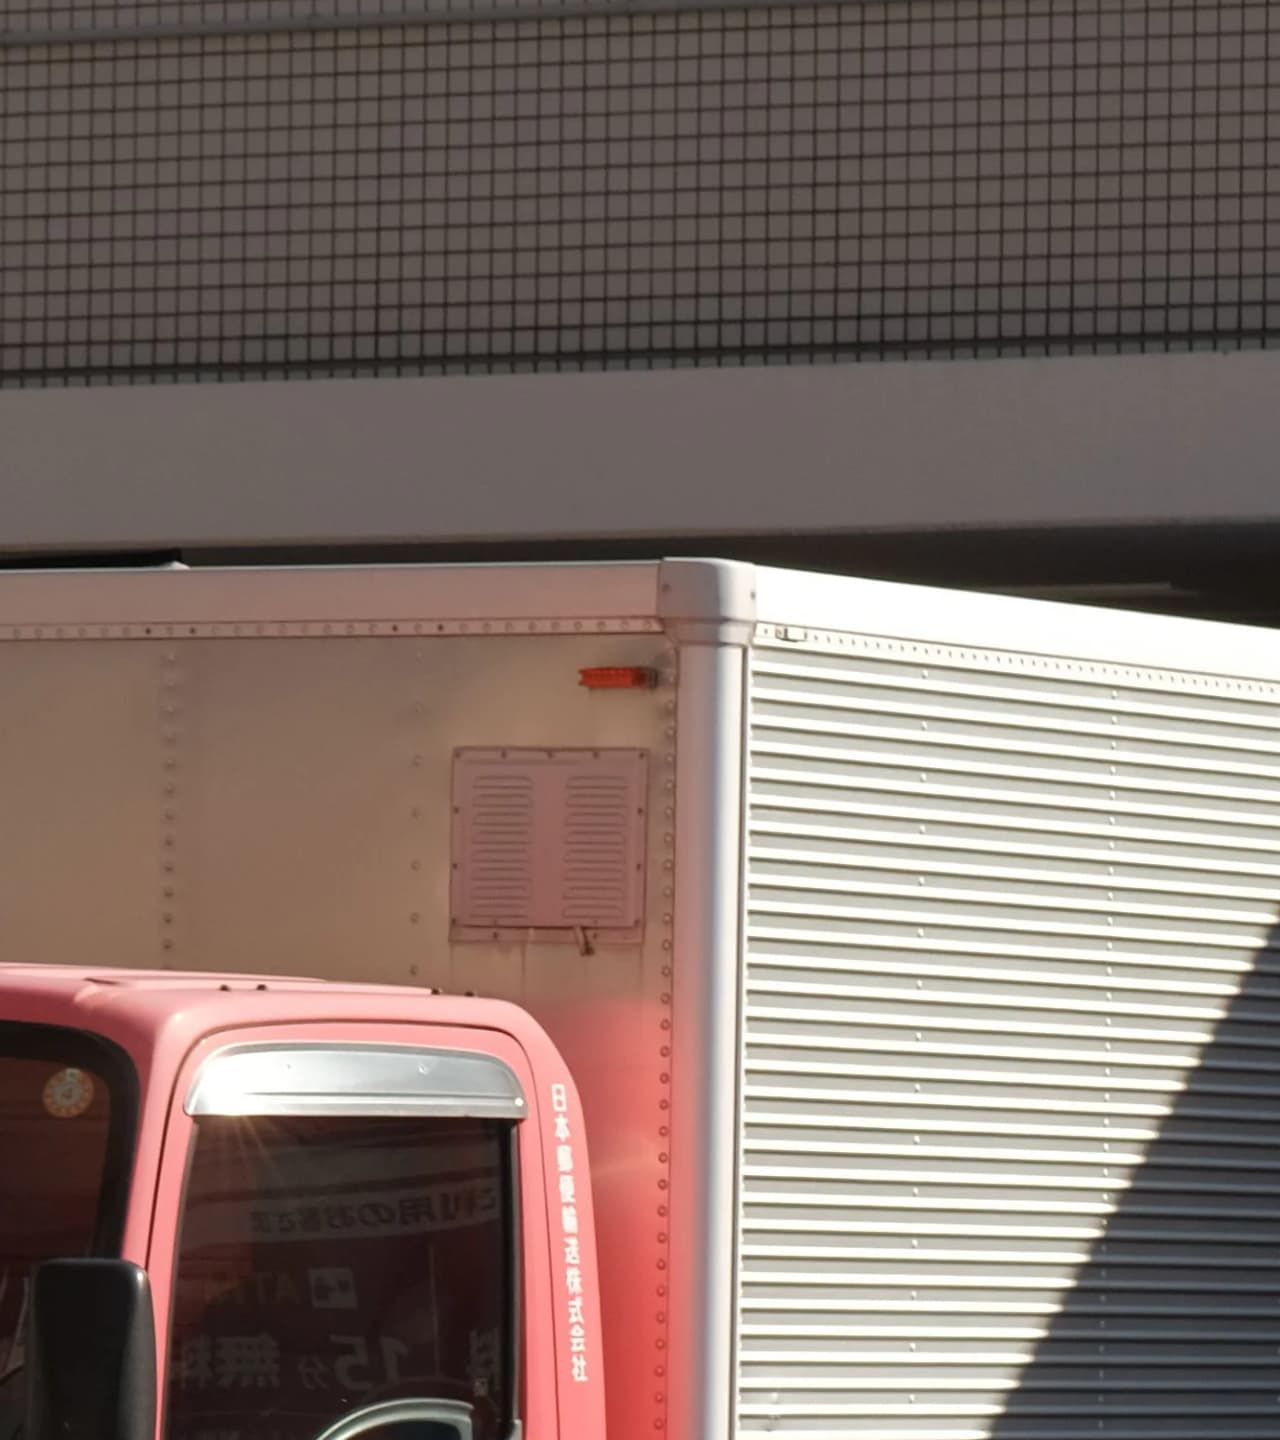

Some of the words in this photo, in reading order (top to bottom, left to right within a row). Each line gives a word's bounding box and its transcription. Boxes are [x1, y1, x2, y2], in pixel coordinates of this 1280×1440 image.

[550, 1082, 588, 1383] 日本郵便輸送株式会社
